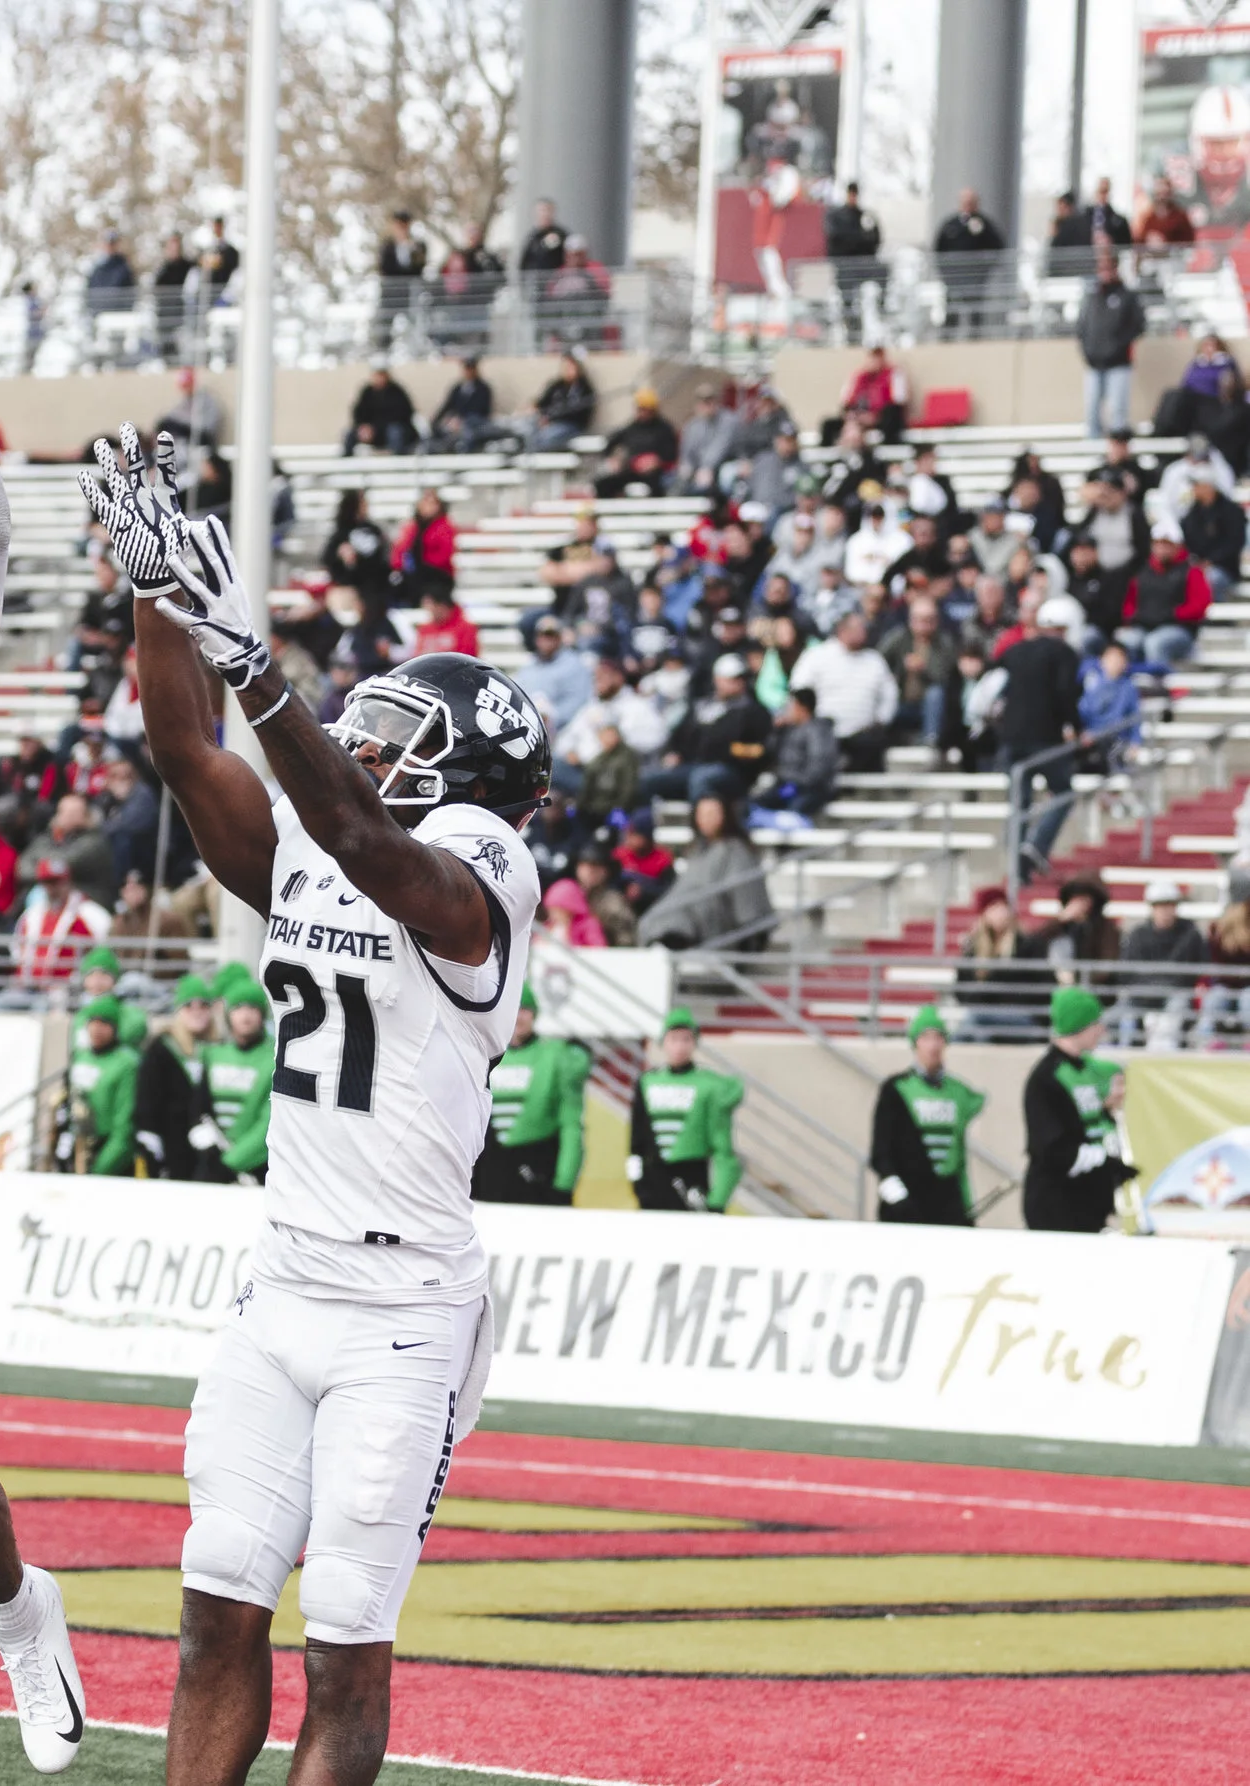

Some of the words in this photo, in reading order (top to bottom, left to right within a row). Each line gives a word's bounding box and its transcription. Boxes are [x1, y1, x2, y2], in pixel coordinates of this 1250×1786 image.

[474, 687, 539, 752] STATE
[269, 913, 304, 946] TAH
[306, 924, 395, 962] STATE
[263, 957, 380, 1117] 21
[489, 1253, 634, 1359] NEW
[640, 1262, 926, 1383] MEXICO
